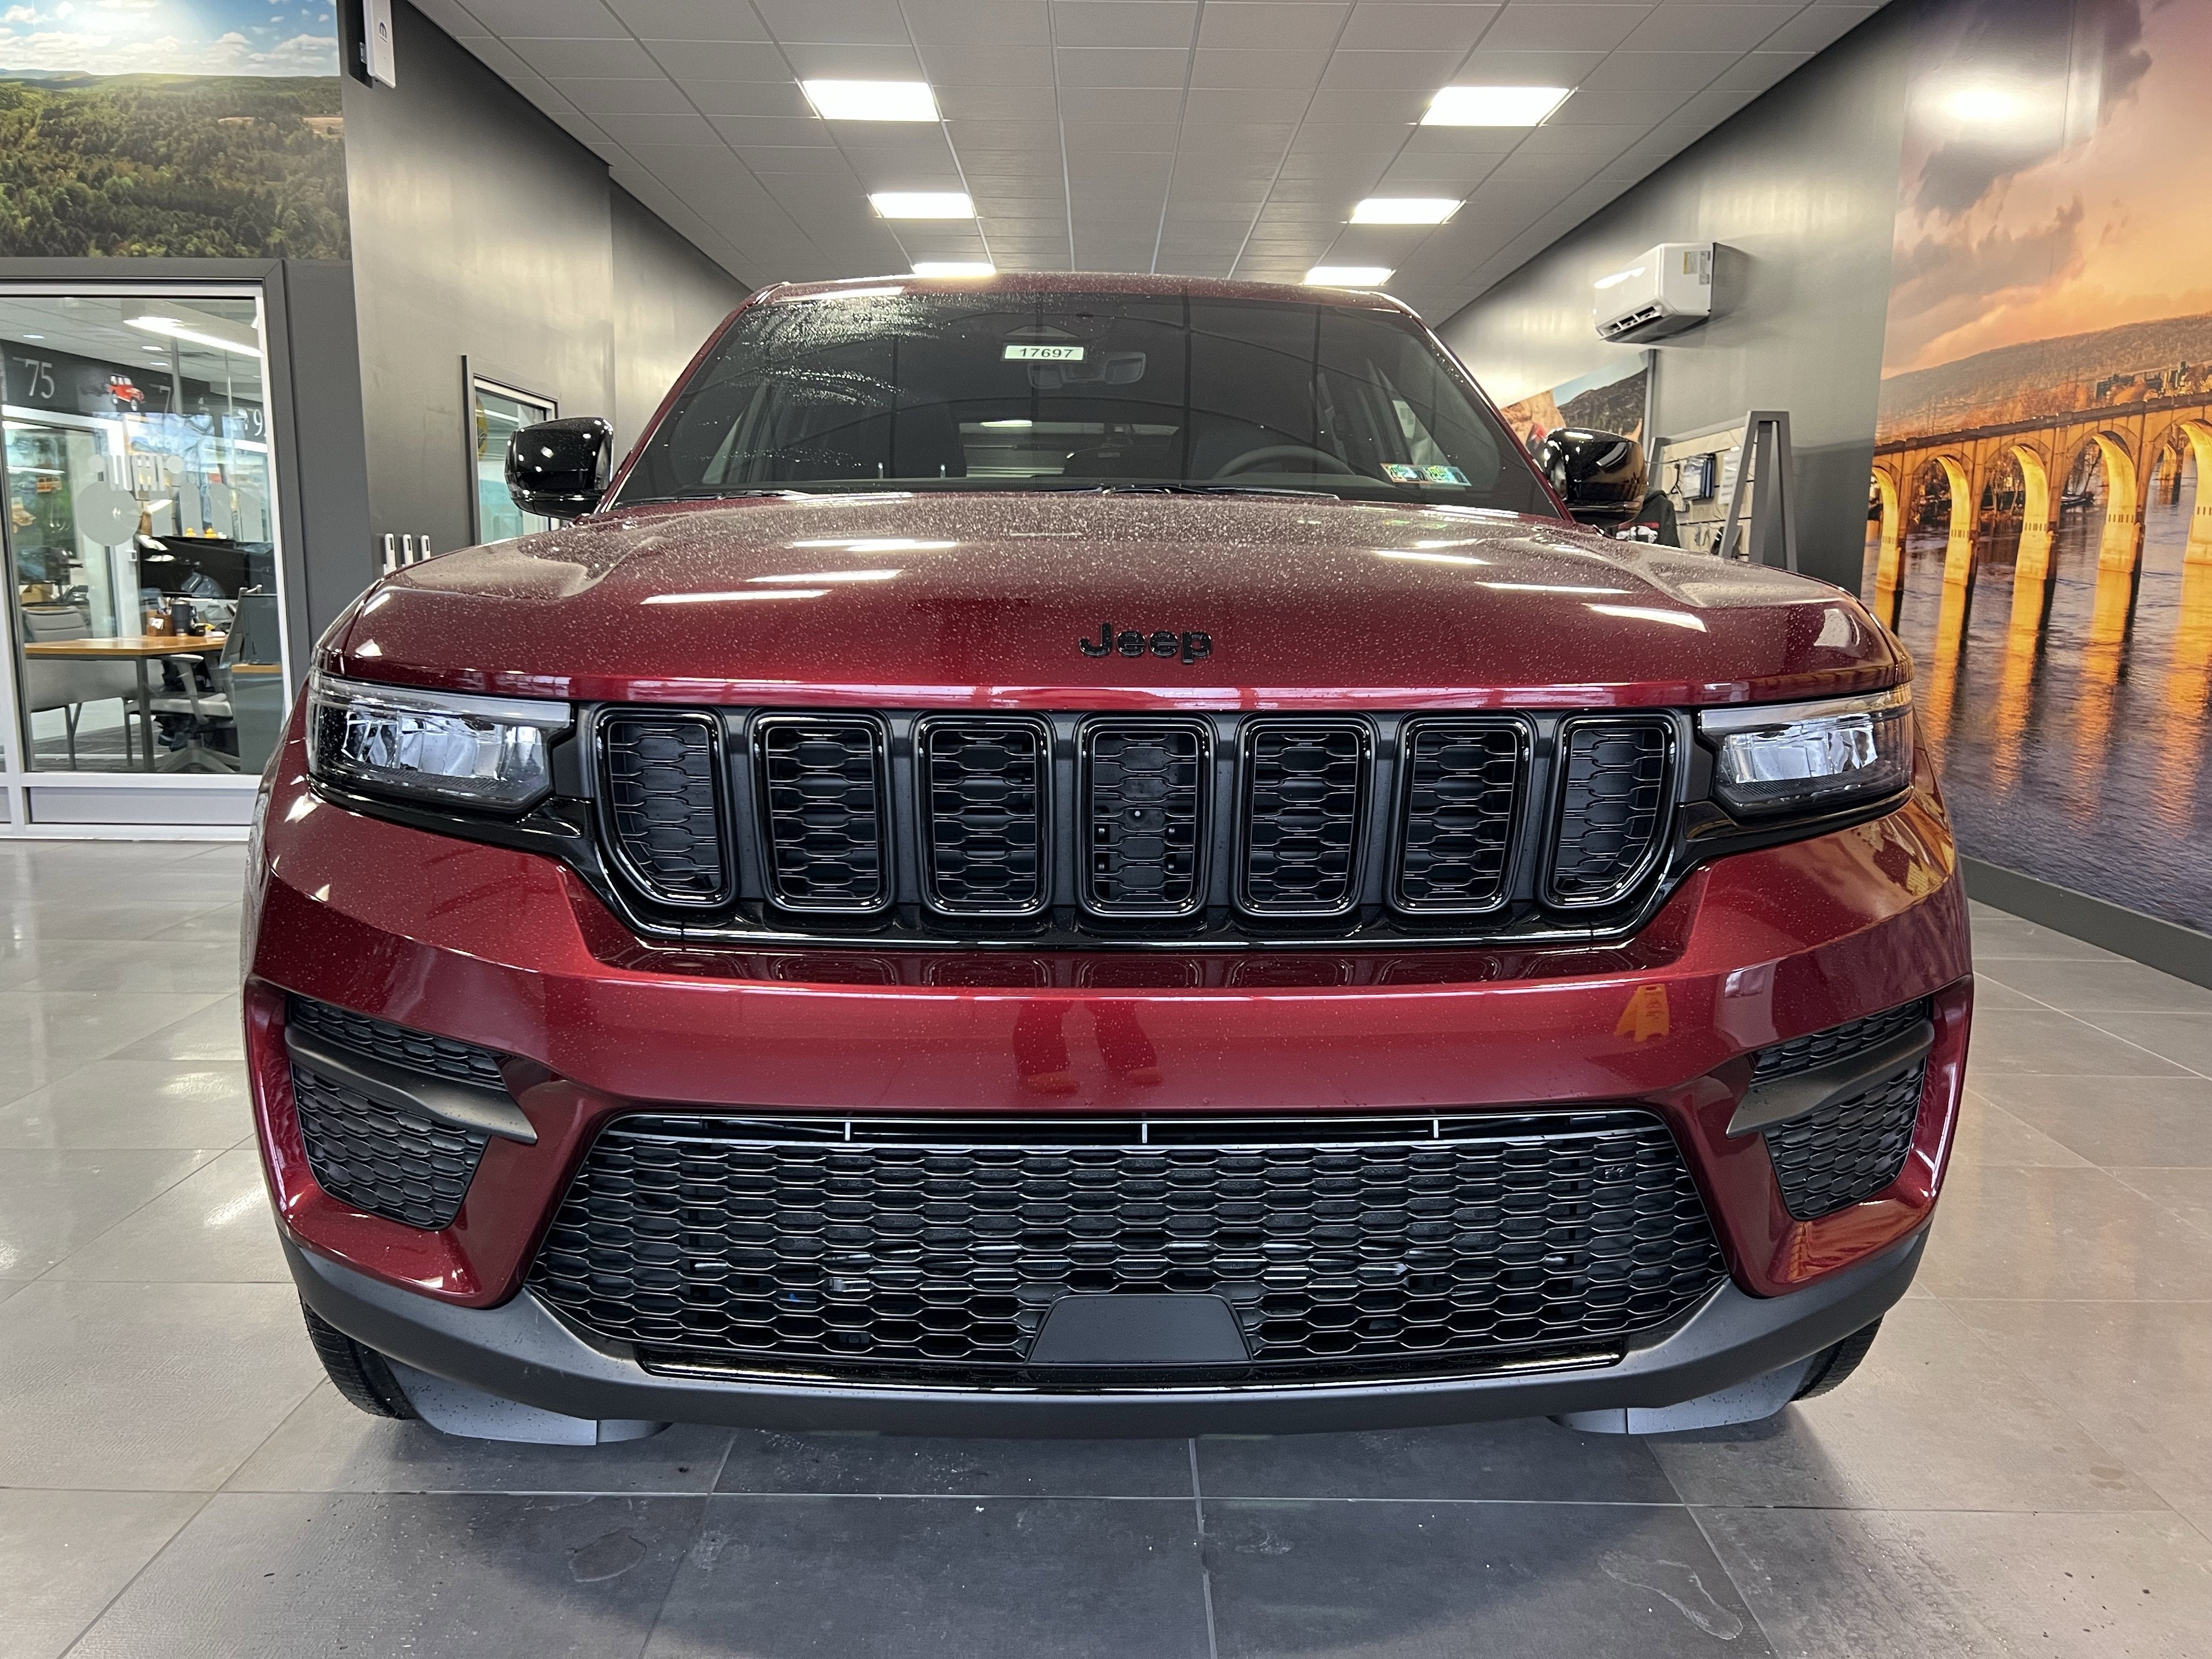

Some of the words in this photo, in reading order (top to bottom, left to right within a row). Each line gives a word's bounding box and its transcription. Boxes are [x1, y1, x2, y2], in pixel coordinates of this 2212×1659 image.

[1020, 348, 1074, 358] 17697
[25, 358, 55, 399] 75
[1078, 622, 1213, 665] Jeep
